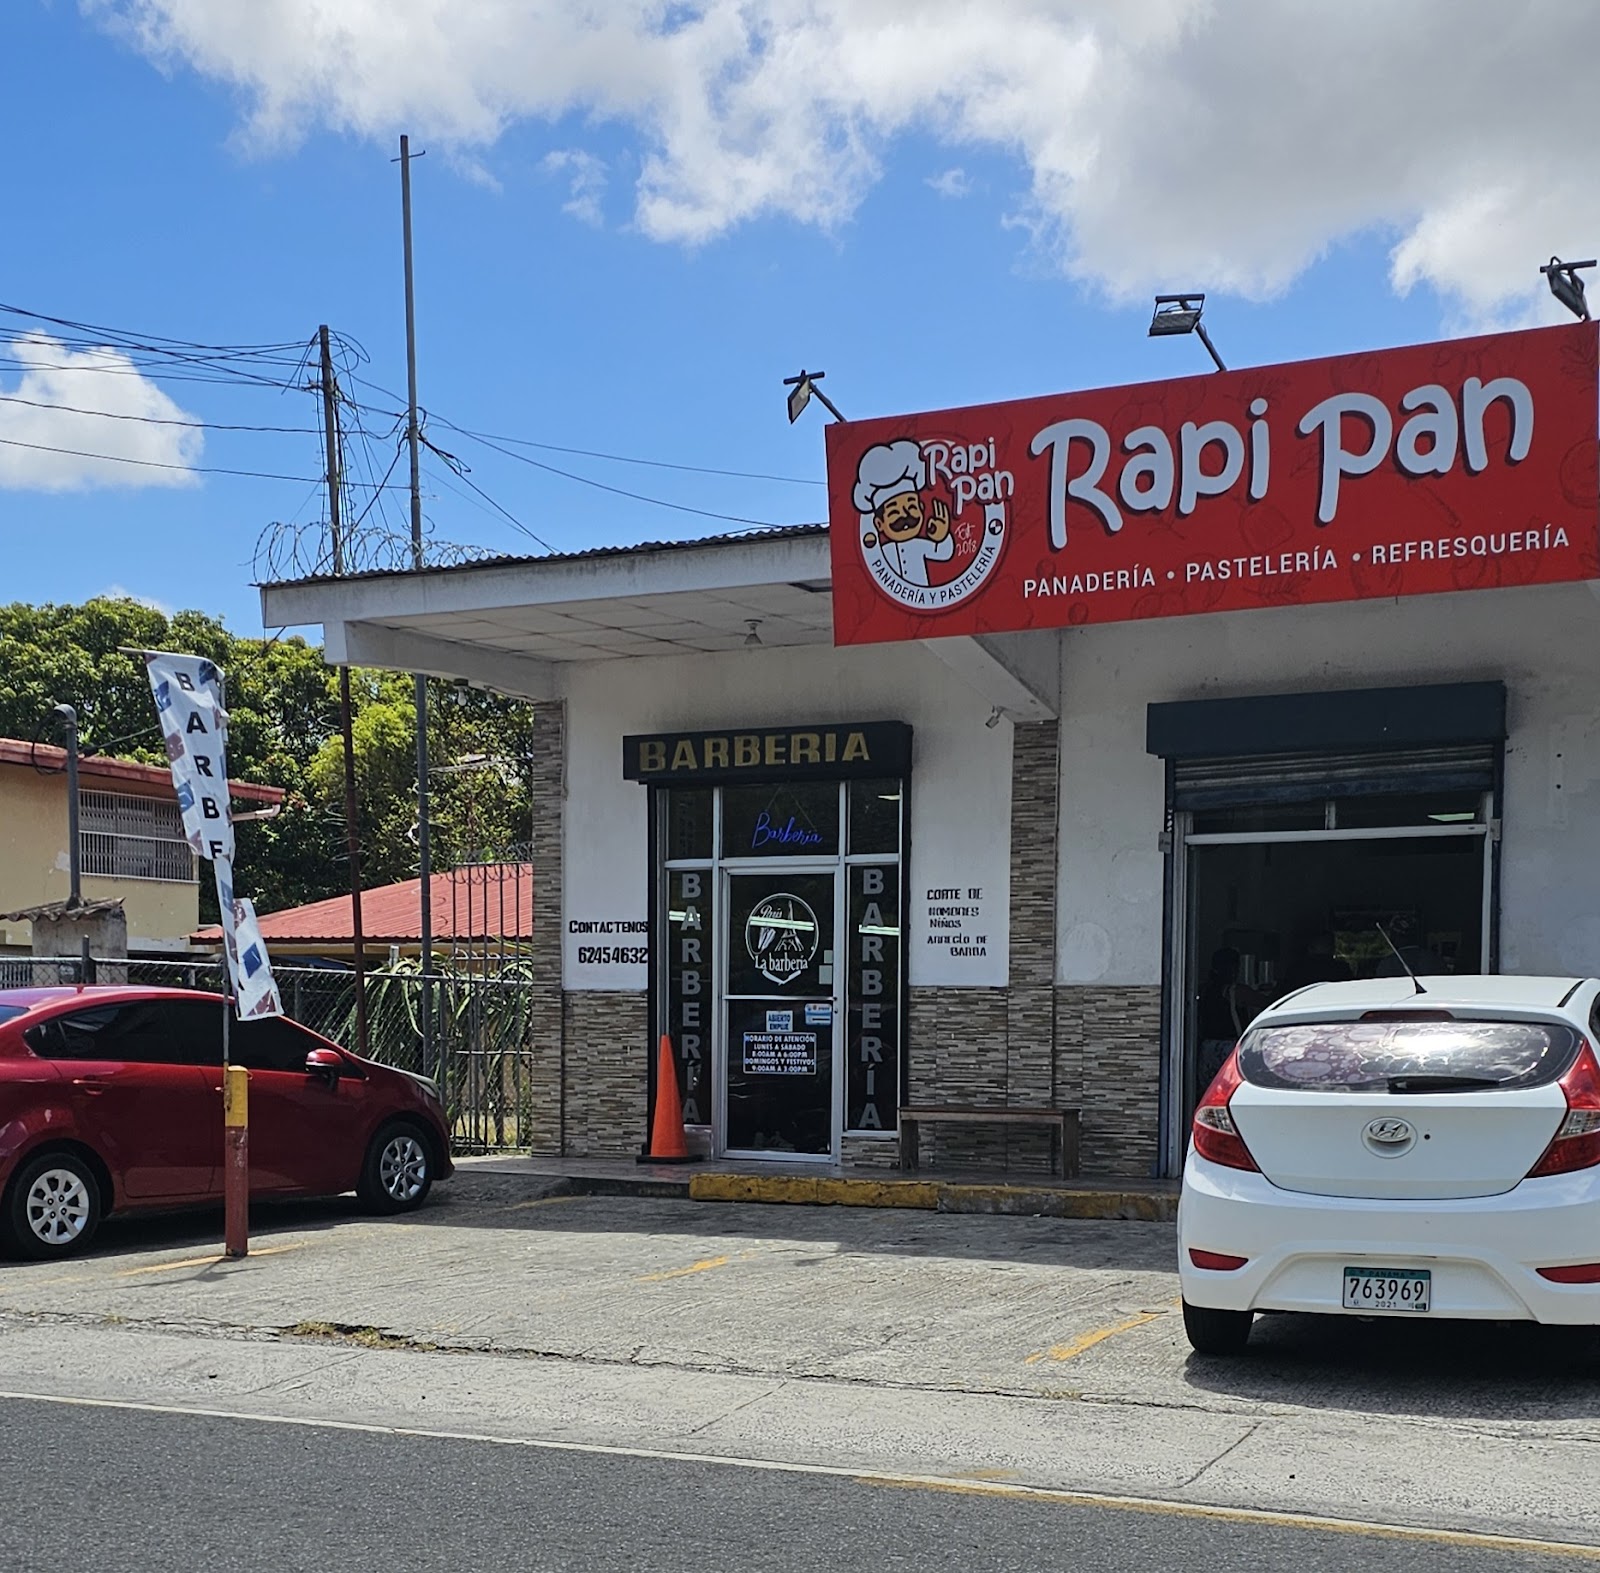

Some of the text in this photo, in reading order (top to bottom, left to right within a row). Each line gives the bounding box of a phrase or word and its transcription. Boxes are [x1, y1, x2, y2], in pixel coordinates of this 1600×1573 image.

[924, 437, 994, 486] Rapi
[1031, 397, 1271, 550] Rapi
[956, 539, 977, 557] 2018
[1023, 522, 1570, 599] PANADERÍA PASTELERÍA REFRESQUERÍA
[872, 546, 996, 604] PANADERÍA Y PASTELERÍA
[639, 732, 871, 772] BARBERIA
[578, 946, 648, 964] 62454632
[754, 955, 767, 970] La
[680, 873, 702, 1124] BARBERÍA
[859, 868, 884, 1129] BARBERÍA
[1350, 1278, 1424, 1301] 763969
